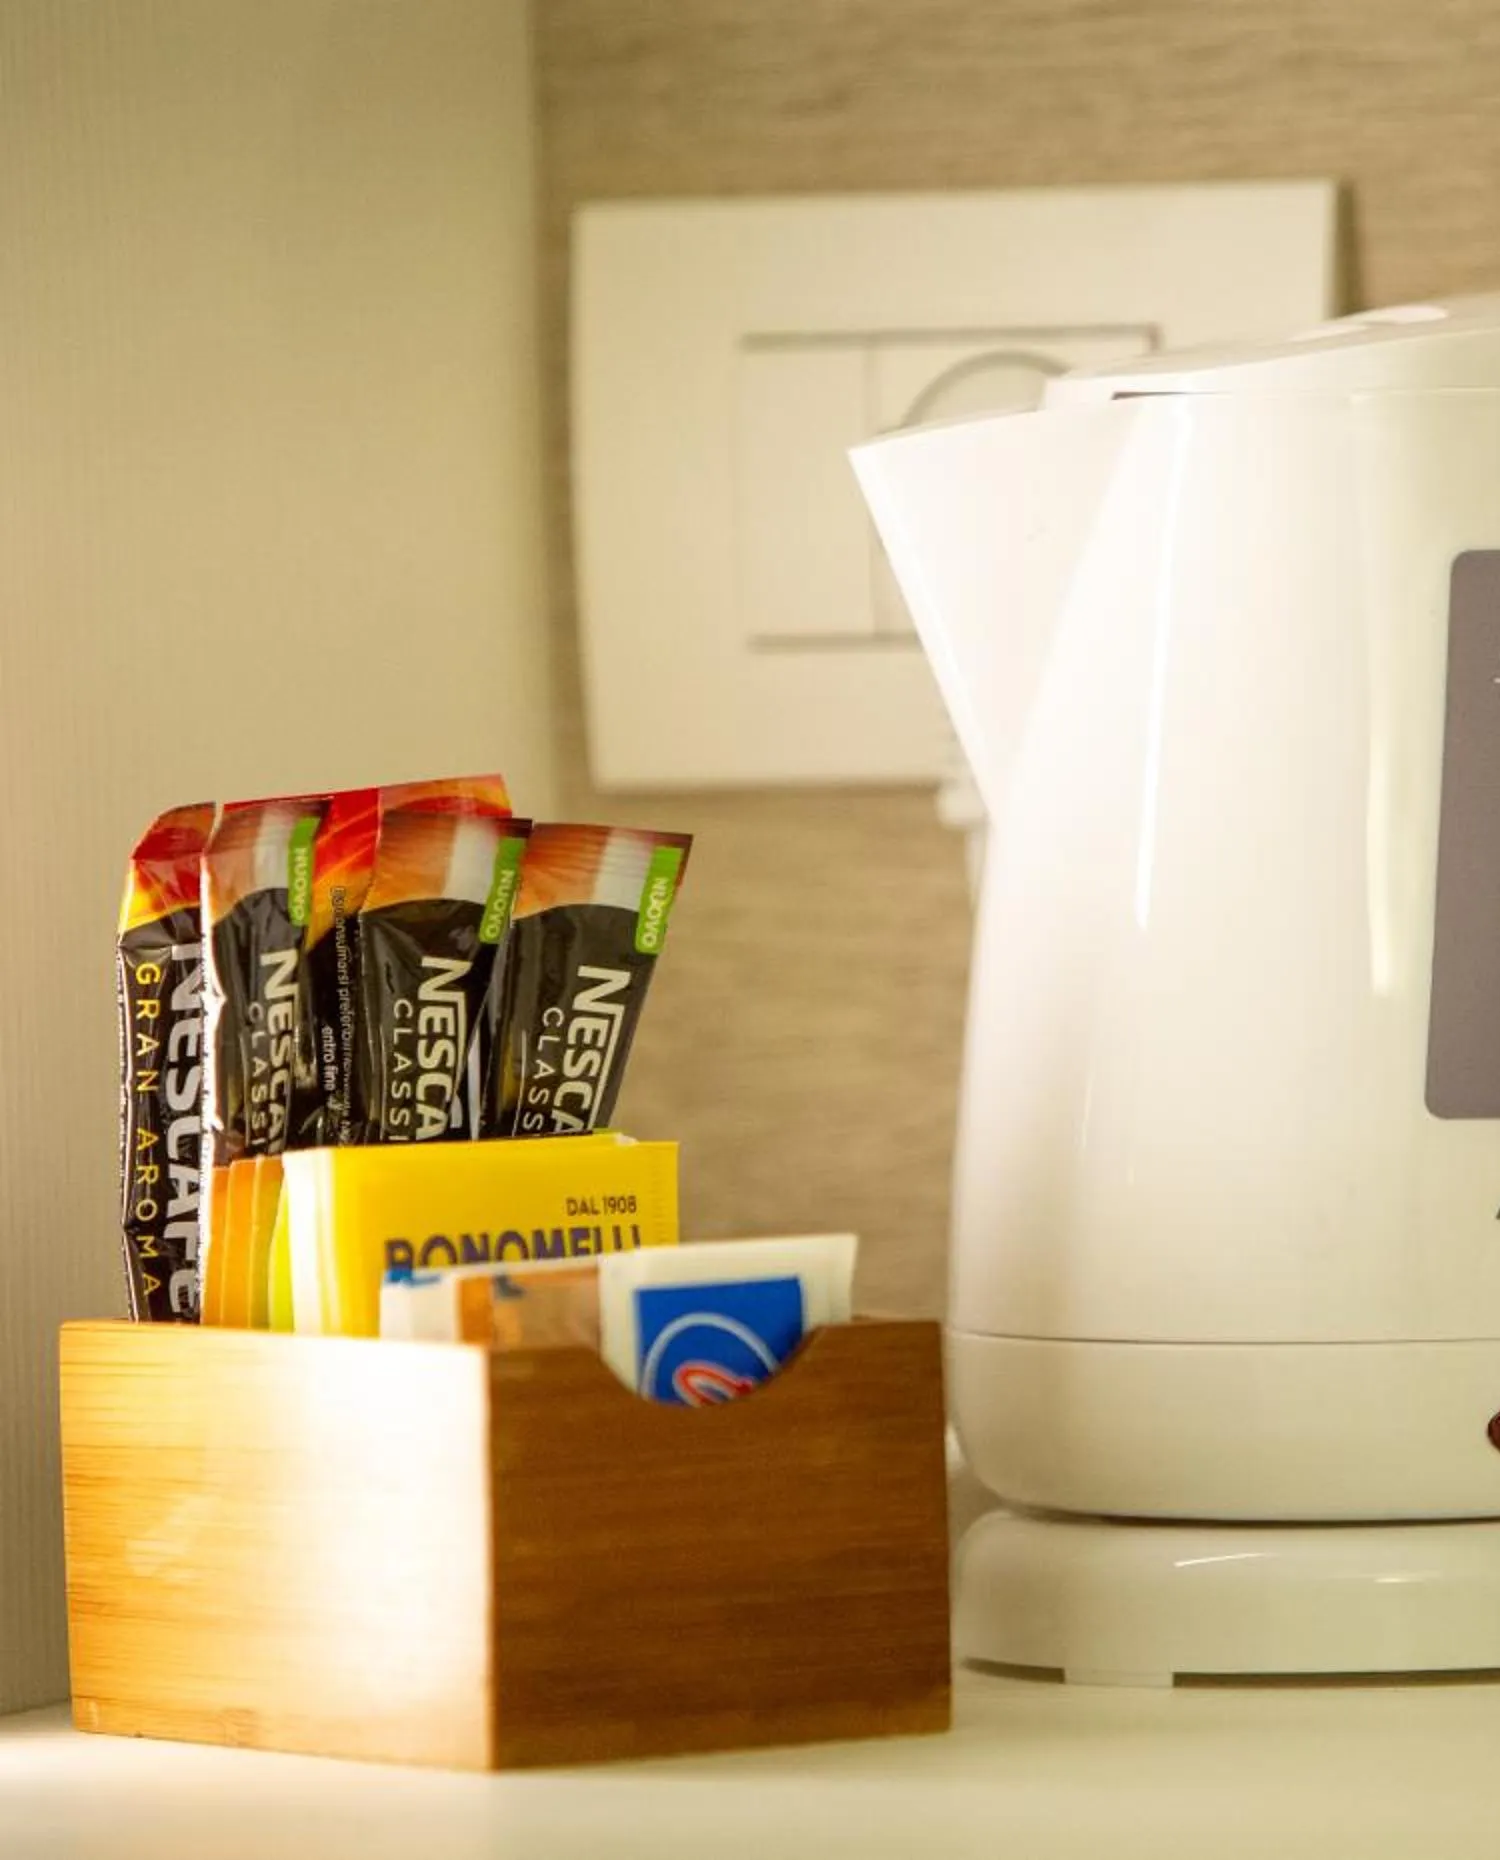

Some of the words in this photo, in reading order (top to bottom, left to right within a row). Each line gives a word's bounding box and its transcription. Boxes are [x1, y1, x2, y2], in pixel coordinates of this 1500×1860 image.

[484, 869, 515, 939] NUOVO
[642, 877, 669, 947] NUOVO
[135, 962, 161, 1091] GRAN
[135, 1127, 161, 1295] AROMA
[566, 1197, 600, 1216] DAL
[603, 1195, 637, 1214] 1908
